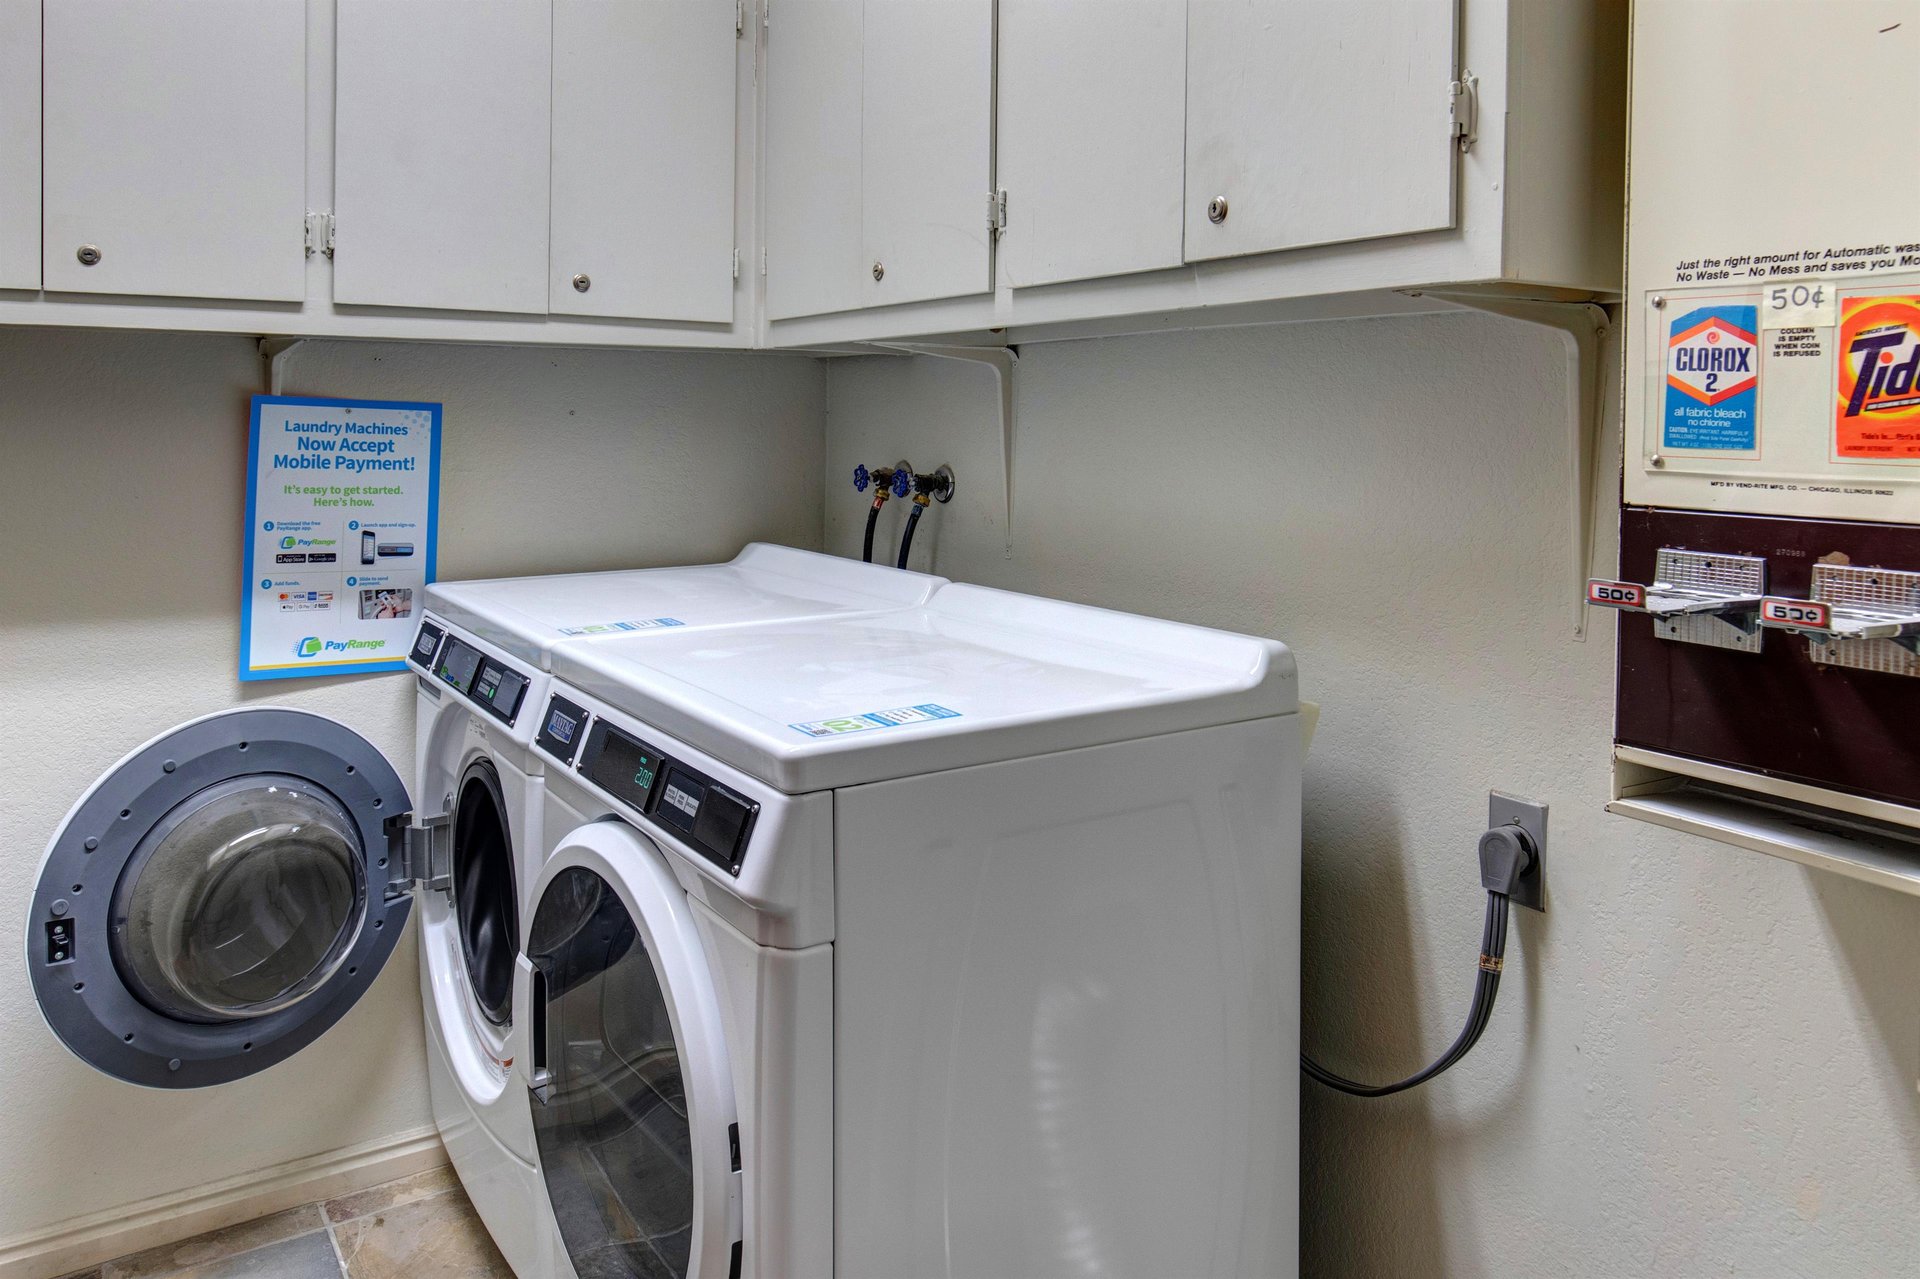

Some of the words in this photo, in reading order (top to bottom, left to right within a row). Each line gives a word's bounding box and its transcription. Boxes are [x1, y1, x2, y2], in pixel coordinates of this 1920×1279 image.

[1676, 260, 1700, 270] Just
[1703, 258, 1721, 268] the
[1724, 256, 1751, 268] right
[1753, 251, 1799, 265] amount
[1803, 250, 1821, 260] for
[1823, 244, 1891, 259] Automatic
[1676, 273, 1693, 282] No
[1696, 270, 1730, 281] Waste
[1748, 267, 1766, 277] No
[1769, 265, 1800, 275] Mess
[1804, 261, 1828, 273] and
[1831, 260, 1866, 271] saves
[1869, 259, 1896, 271] you
[1771, 285, 1826, 310] 50¢
[1676, 347, 1751, 372] CLOROX
[1705, 373, 1718, 392] 2
[1844, 331, 1920, 418] Tid
[1674, 407, 1685, 417] all
[1686, 407, 1712, 417] fabric
[1714, 407, 1747, 419] bleach
[285, 420, 342, 436] Laundry
[345, 422, 409, 435] Machines
[1700, 419, 1732, 427] chlorine
[297, 437, 336, 451] Now
[339, 438, 395, 455] Accept
[273, 454, 331, 469] Mobile
[335, 455, 415, 473] Payment!
[284, 485, 301, 494] It's
[303, 486, 328, 496] easy
[330, 486, 341, 494] to
[343, 486, 360, 496] get
[363, 485, 404, 494] started.
[313, 497, 347, 506] Here's
[350, 497, 375, 506] how.
[1598, 587, 1635, 601] 50¢
[325, 640, 386, 652] PayRange
[551, 712, 574, 735] MAYTAG
